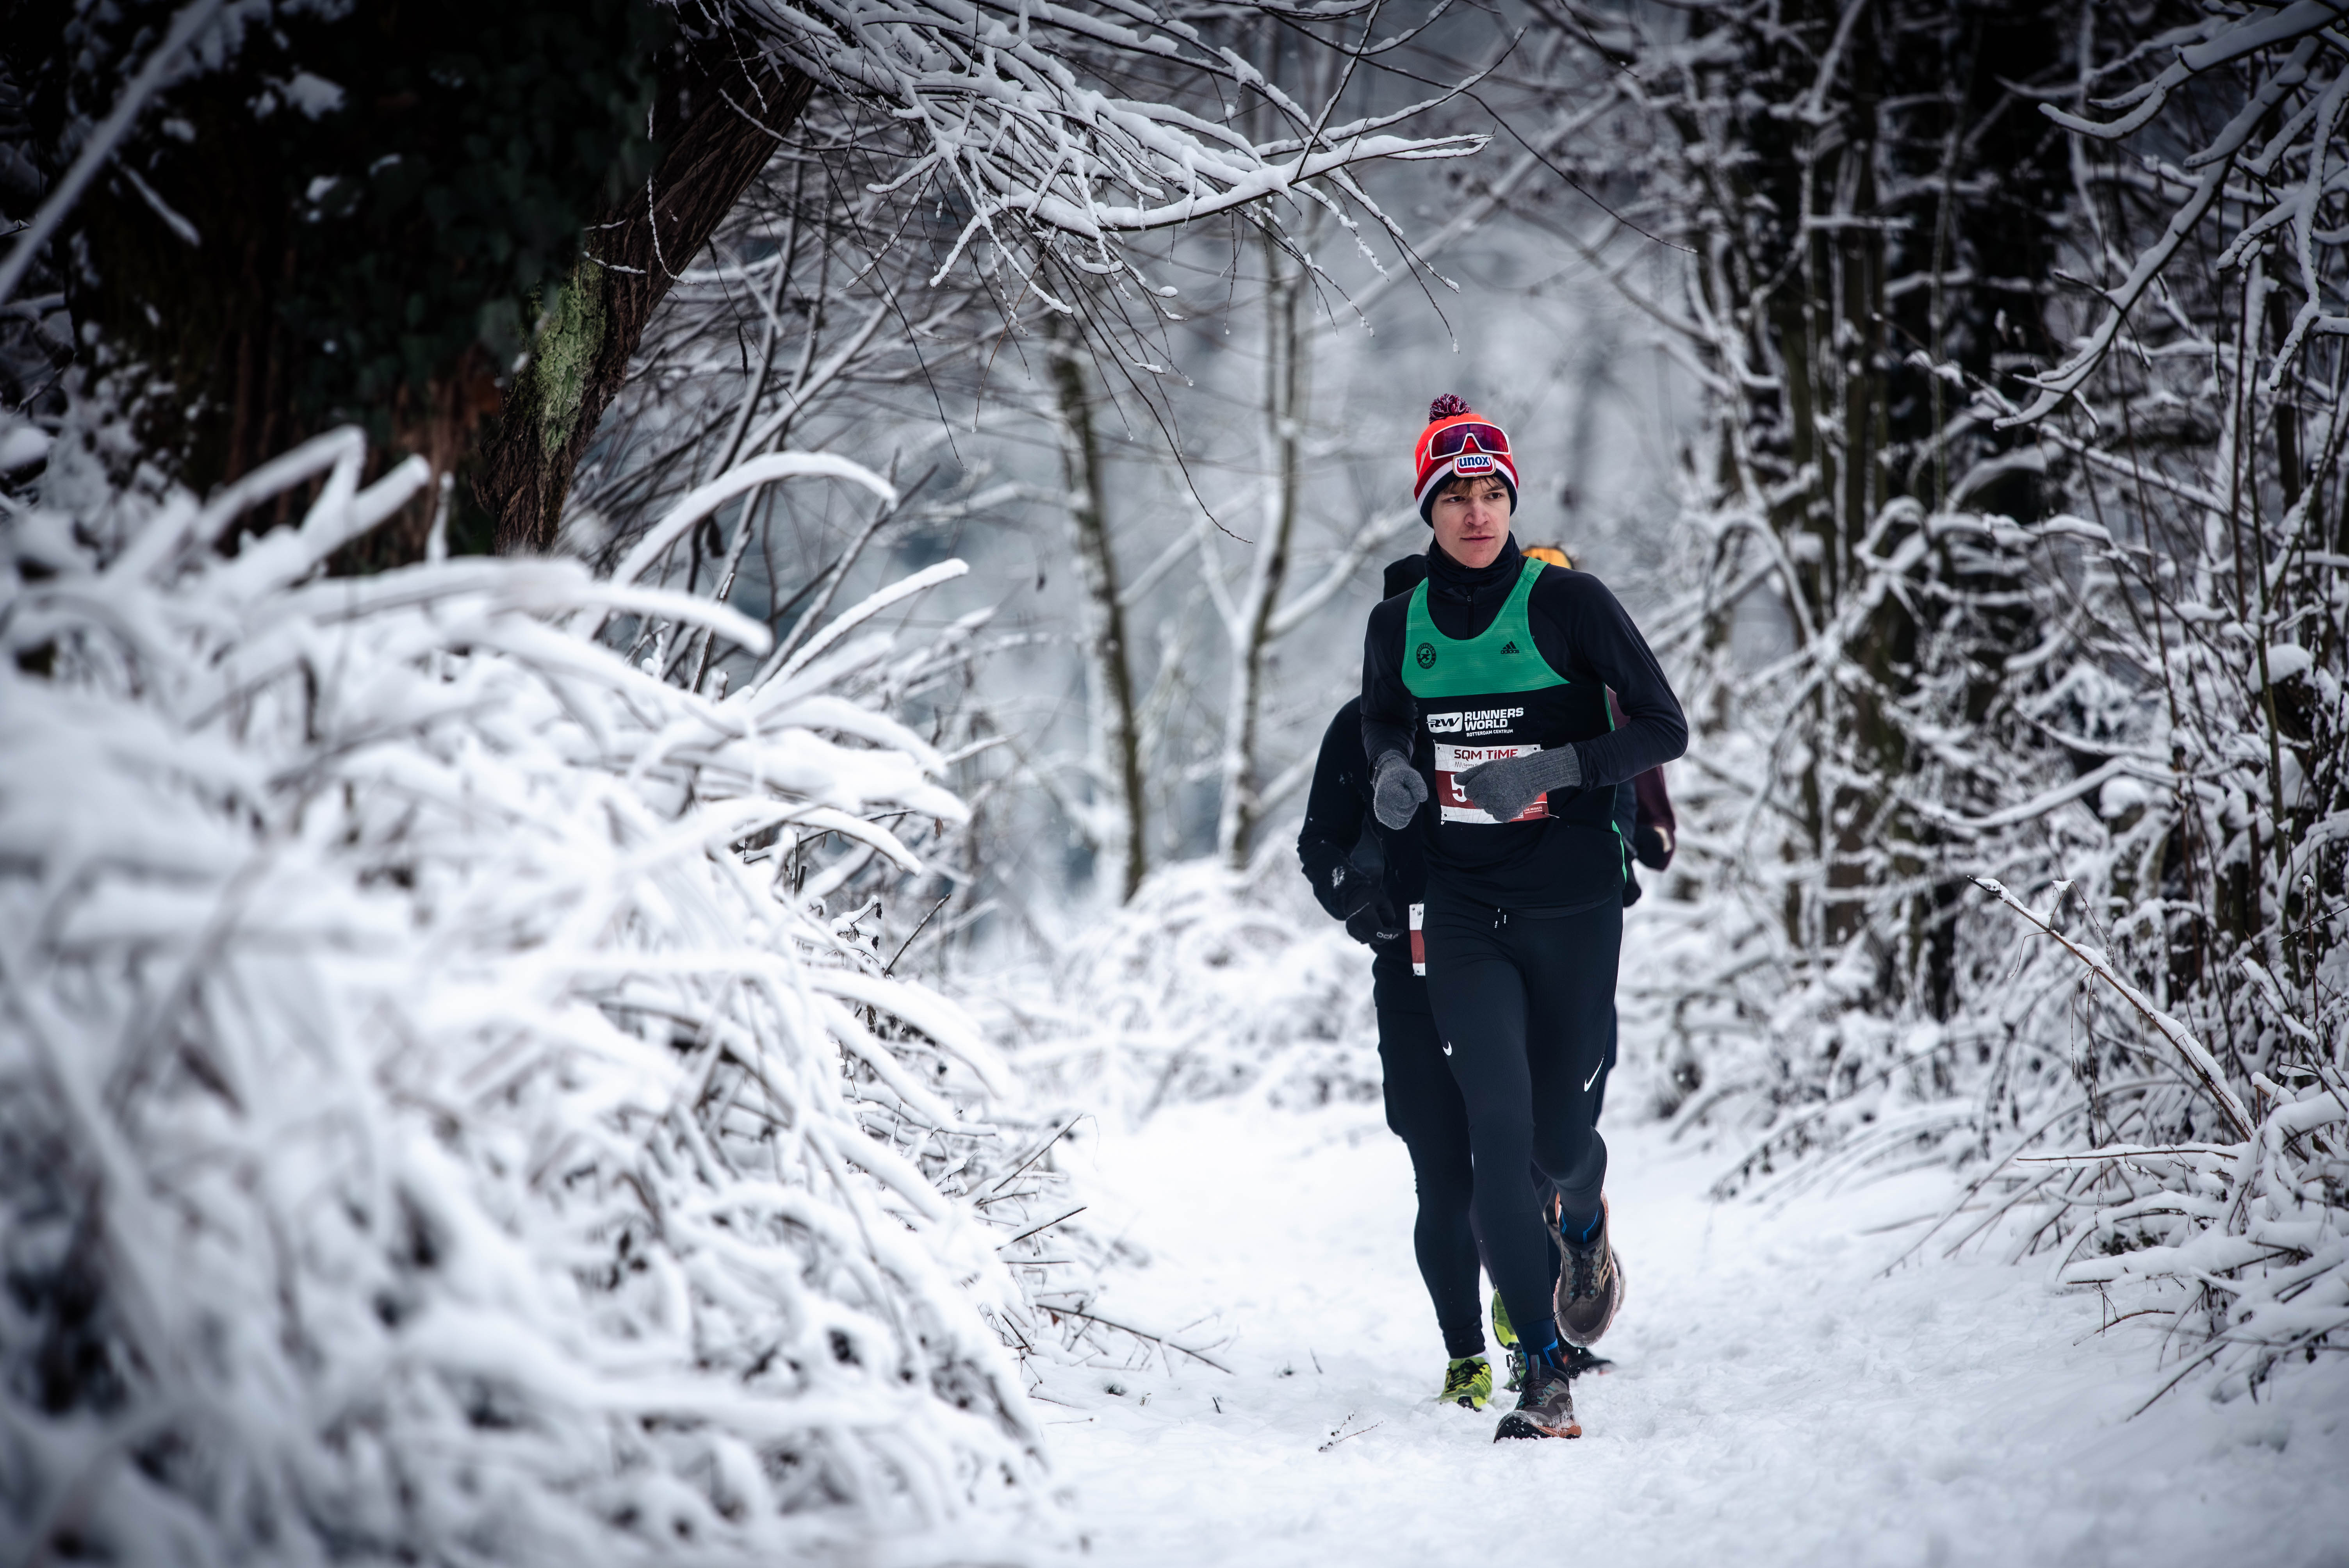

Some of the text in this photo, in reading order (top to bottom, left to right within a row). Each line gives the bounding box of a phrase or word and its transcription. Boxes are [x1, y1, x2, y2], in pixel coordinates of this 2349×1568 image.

[1459, 456, 1490, 467] unox
[1464, 707, 1524, 722] RUNNERS
[1426, 717, 1461, 728] RW
[1464, 718, 1508, 731] WORLD
[1454, 748, 1518, 762] SQM TIME
